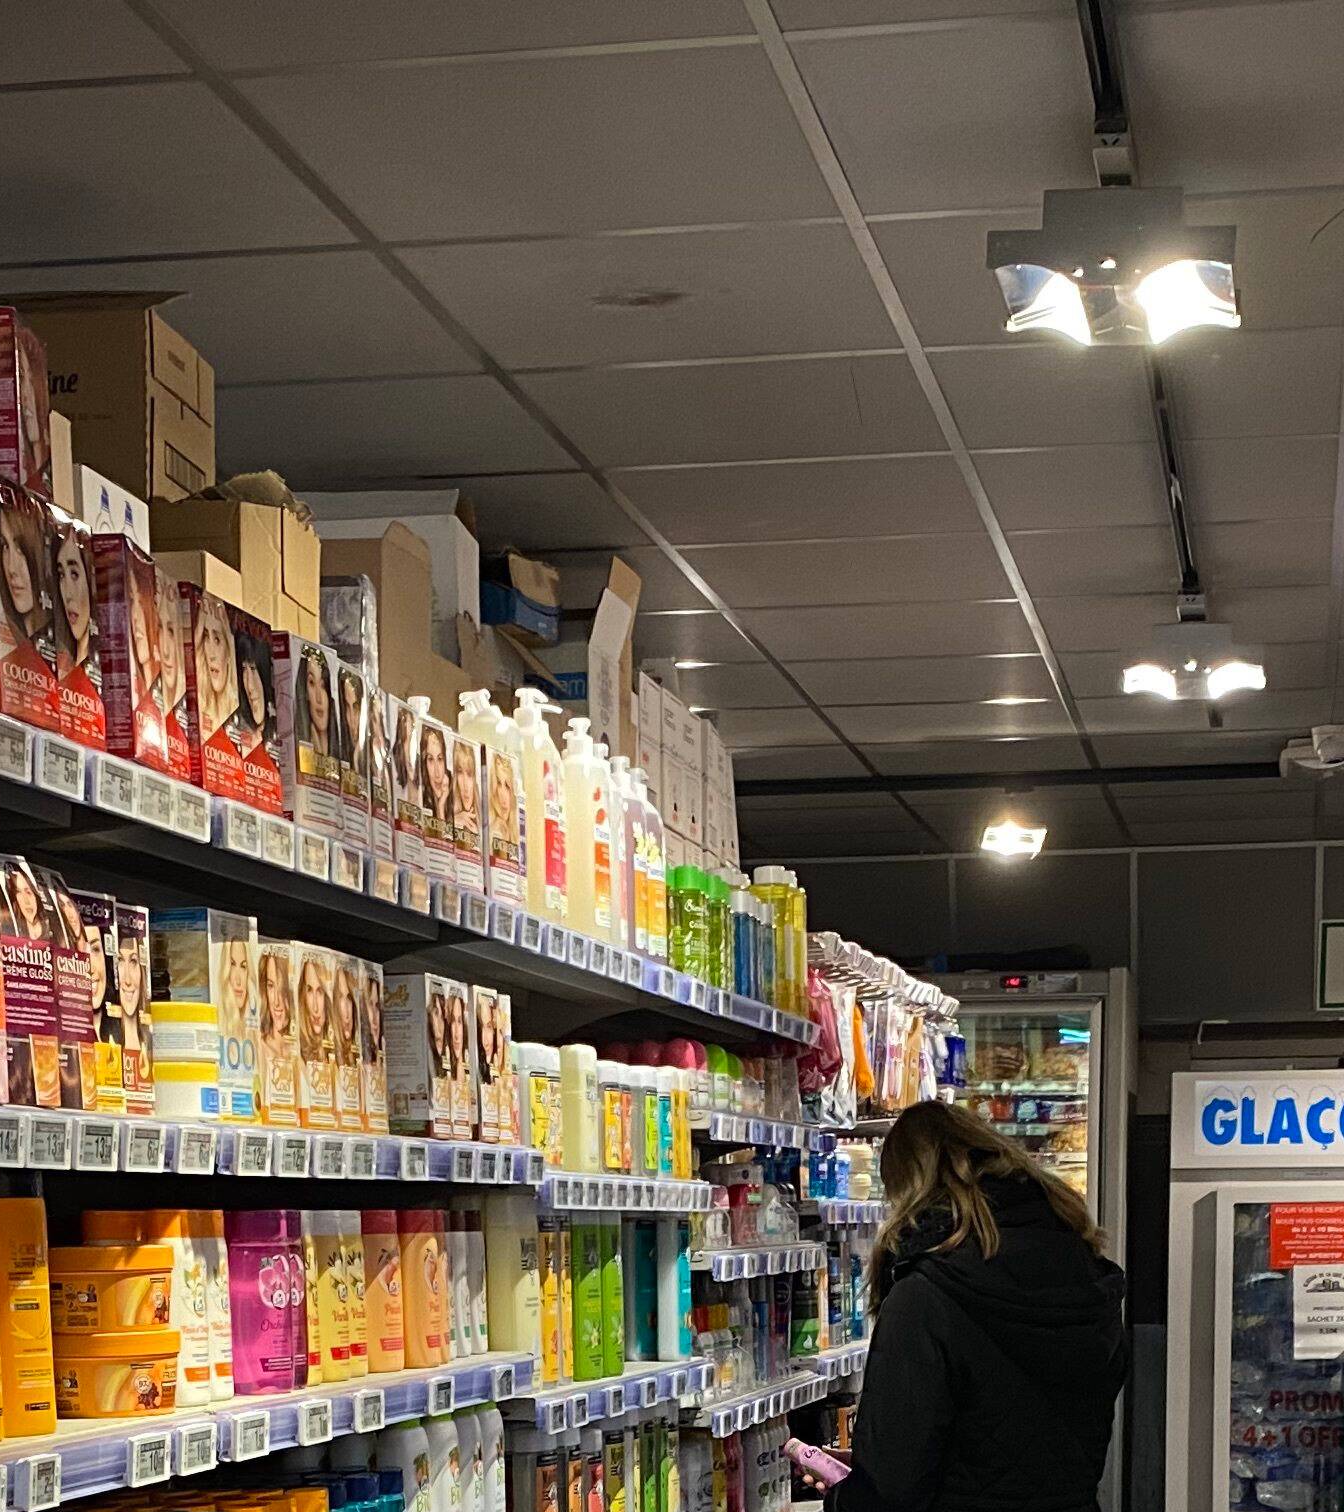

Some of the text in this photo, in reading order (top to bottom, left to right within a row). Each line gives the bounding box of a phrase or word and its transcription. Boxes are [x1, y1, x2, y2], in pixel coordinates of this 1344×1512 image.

[2, 661, 58, 692] COLORSILK
[1, 944, 52, 974] casting
[57, 955, 90, 980] casting
